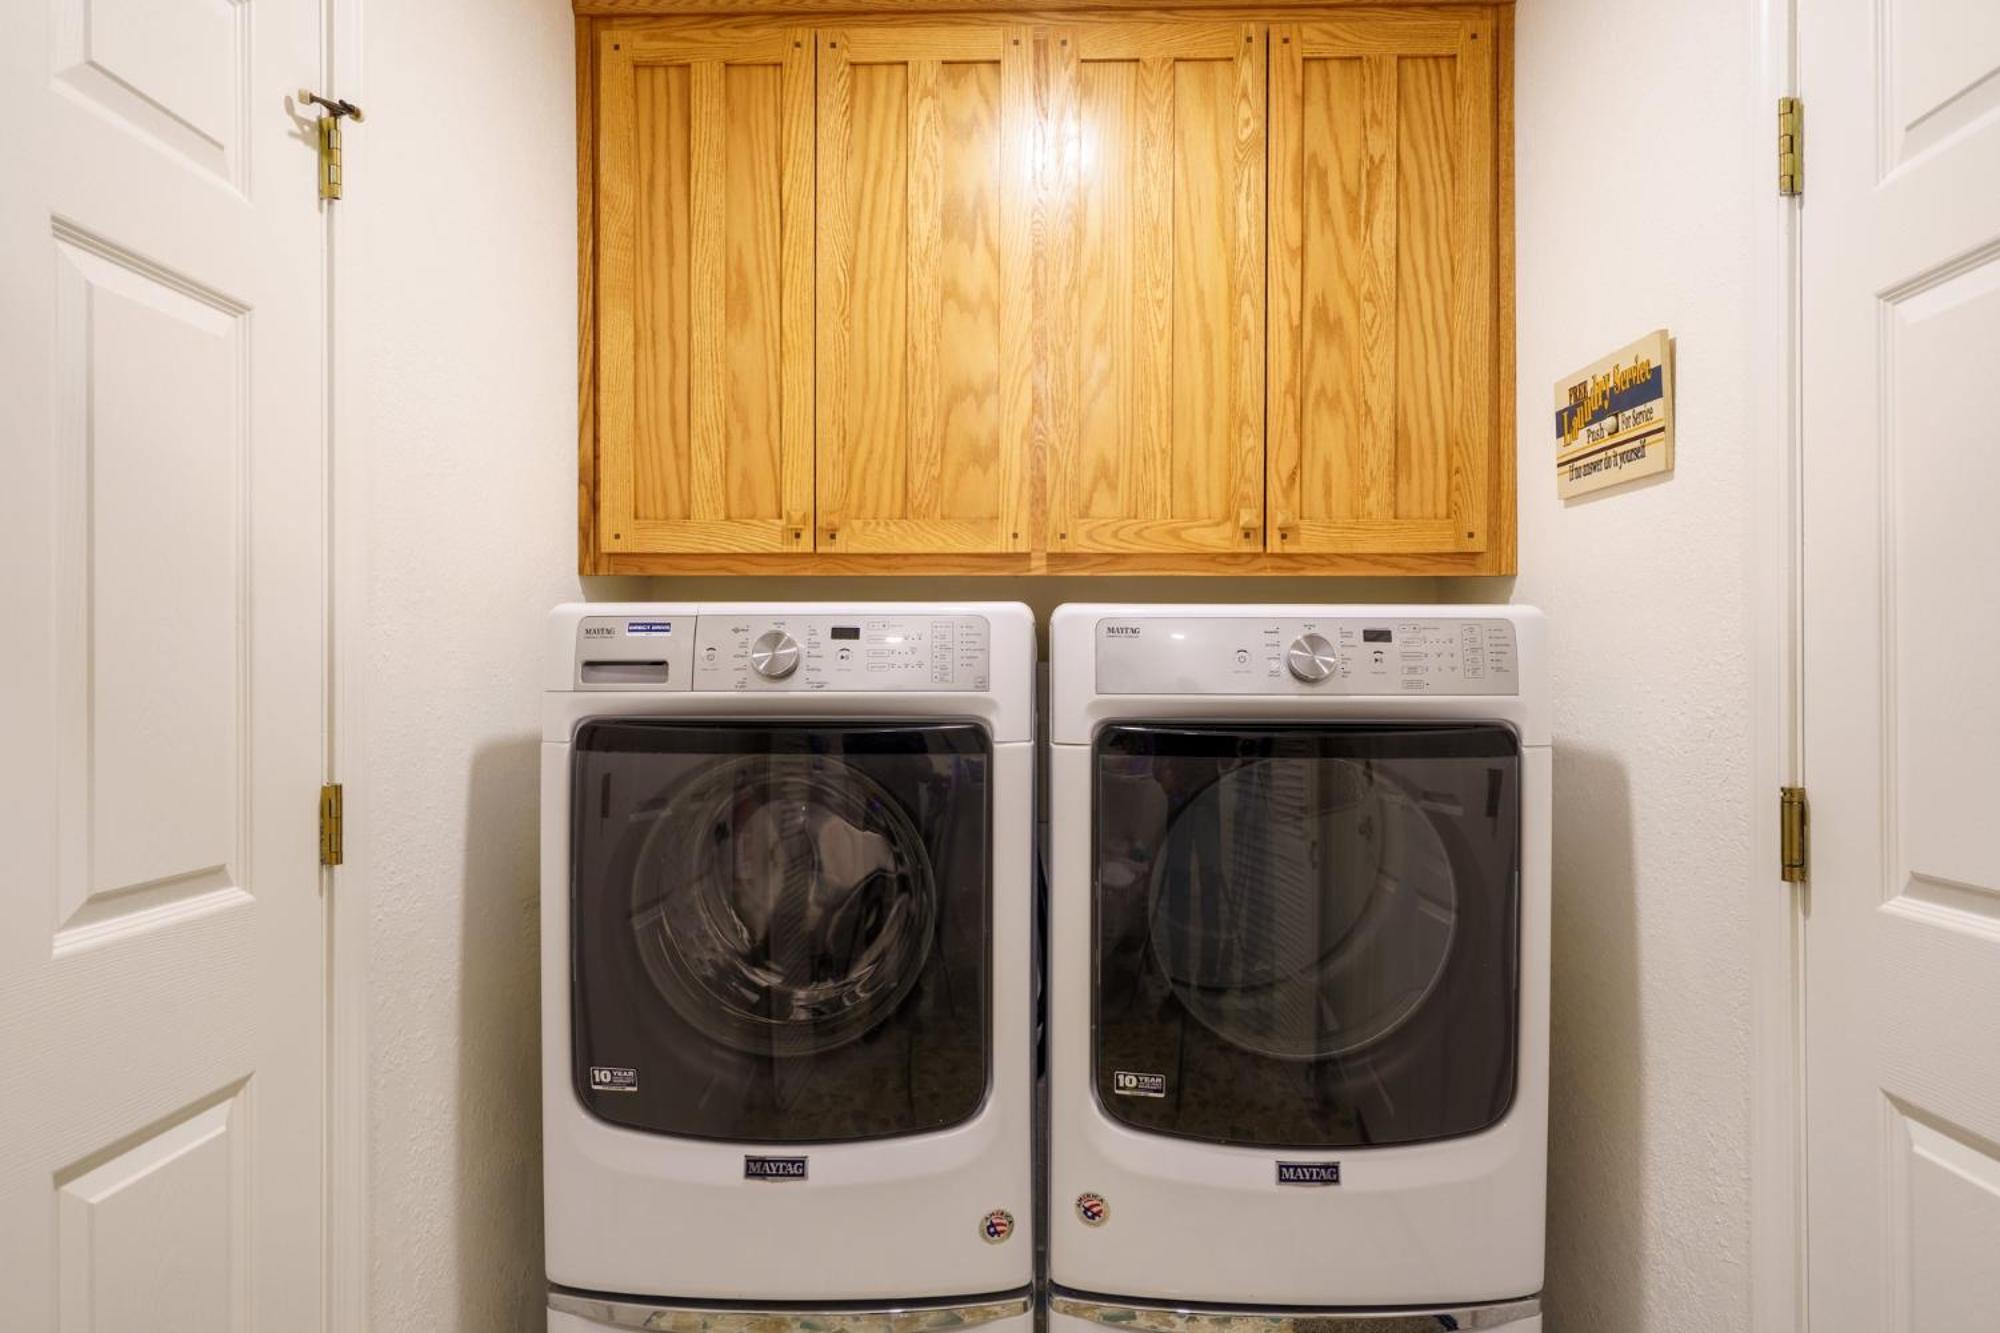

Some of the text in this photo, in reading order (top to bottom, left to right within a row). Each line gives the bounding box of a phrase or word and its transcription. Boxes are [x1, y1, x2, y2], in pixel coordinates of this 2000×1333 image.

[1568, 380, 1589, 406] FREE
[1562, 354, 1652, 447] Laundry Service
[1586, 404, 1654, 444] Push For Service
[1583, 459, 1603, 477] answer
[1604, 451, 1612, 470] do
[1619, 438, 1647, 470] yourself
[585, 627, 616, 635] MAYTAG
[1107, 626, 1140, 634] MAYTAG
[593, 1070, 611, 1083] 10
[1118, 1074, 1137, 1088] 10
[748, 1161, 803, 1174] MAYTAG
[1281, 1167, 1337, 1180] MAYTAG
